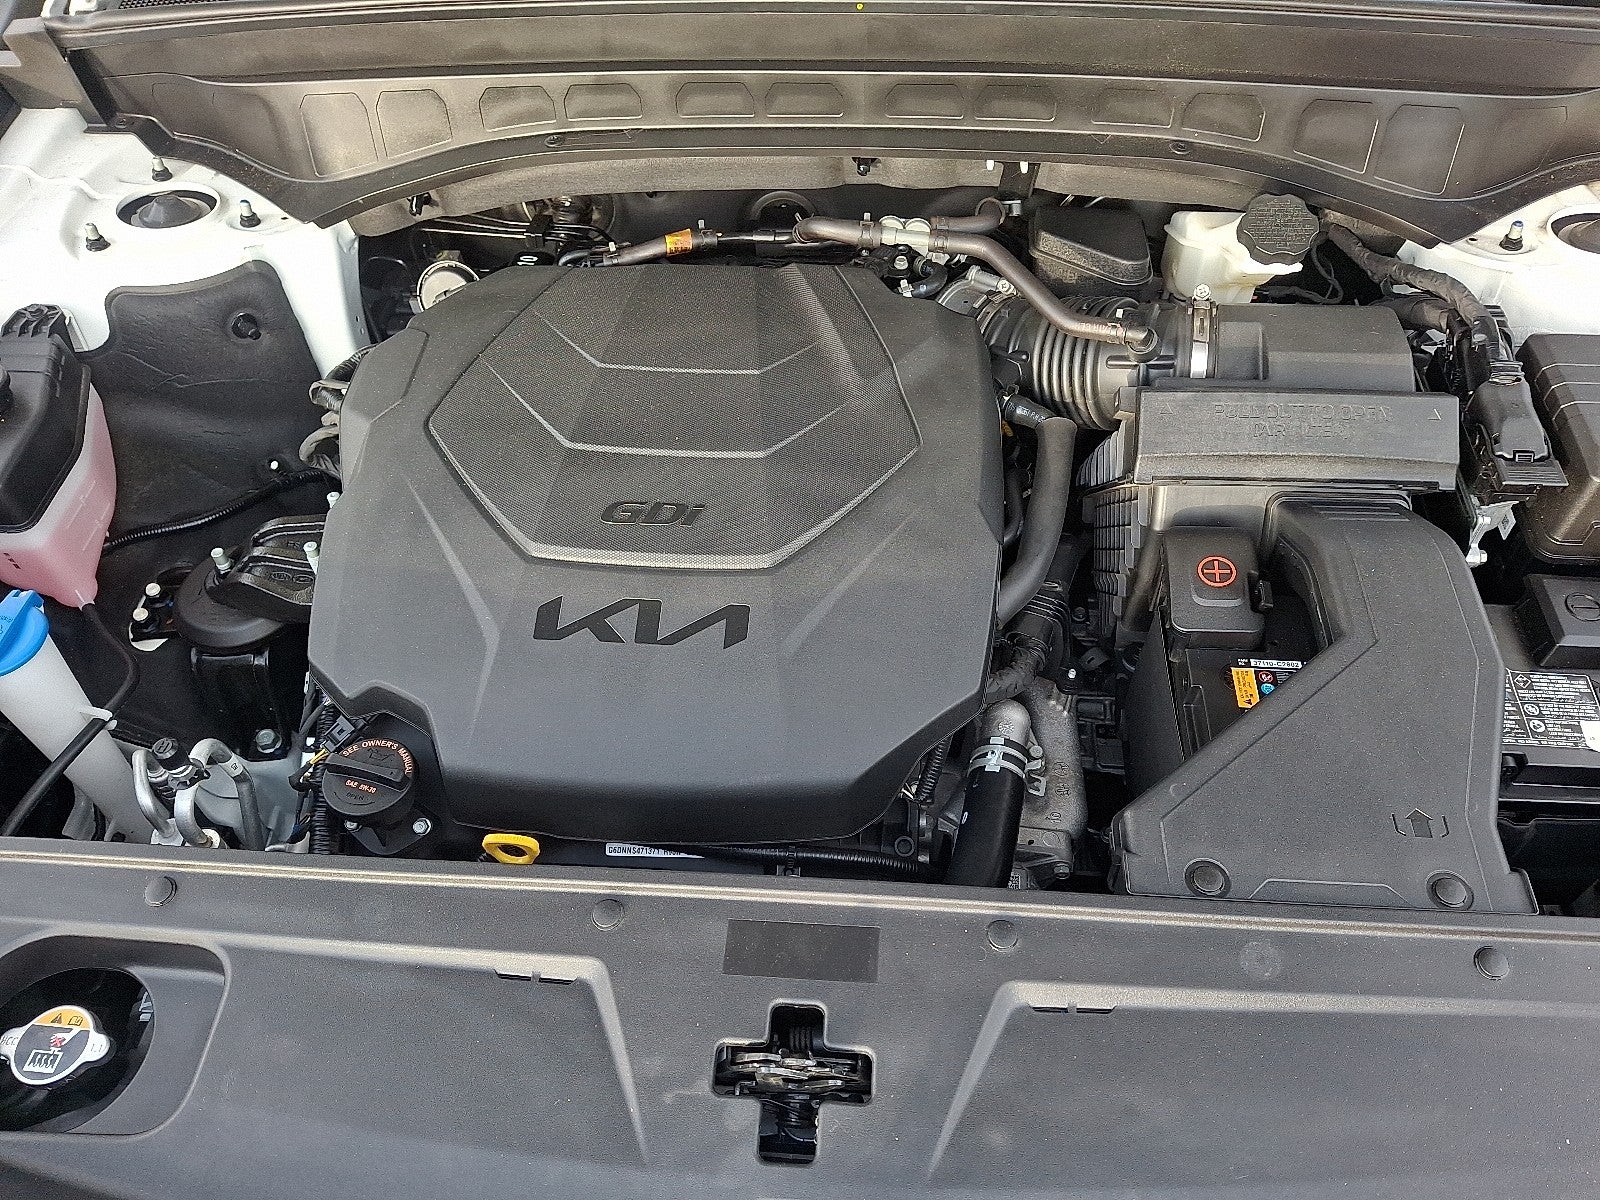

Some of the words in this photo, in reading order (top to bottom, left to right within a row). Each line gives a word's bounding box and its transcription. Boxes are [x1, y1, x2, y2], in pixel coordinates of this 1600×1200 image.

[599, 500, 707, 527] GDi
[533, 595, 751, 650] KIA
[342, 745, 360, 757] SEE
[361, 739, 399, 750] OWNER'S
[397, 747, 413, 775] MANUAL
